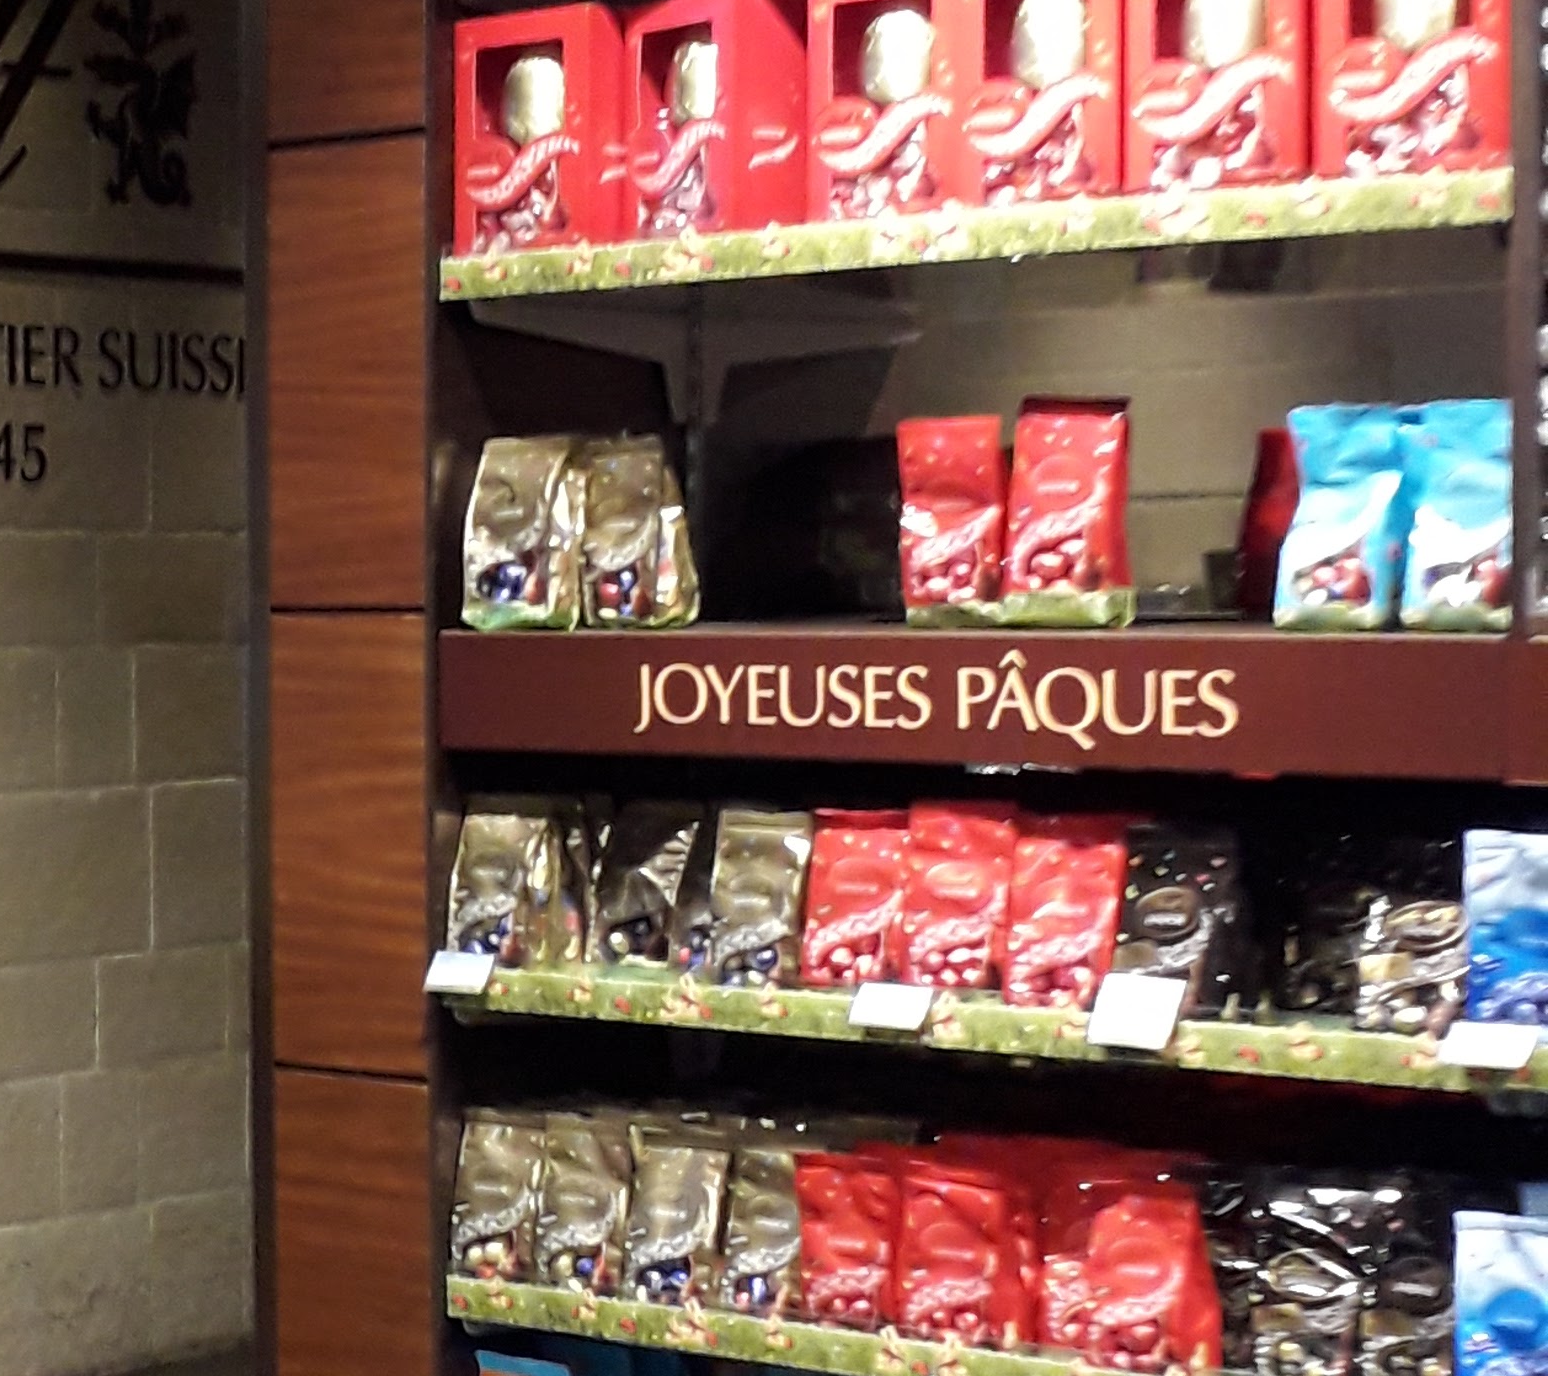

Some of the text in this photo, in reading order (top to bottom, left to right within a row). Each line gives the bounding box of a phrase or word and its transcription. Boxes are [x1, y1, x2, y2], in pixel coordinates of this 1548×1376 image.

[98, 330, 246, 402] SUISS
[633, 649, 1239, 750] JOYEUSES PÂQUES
